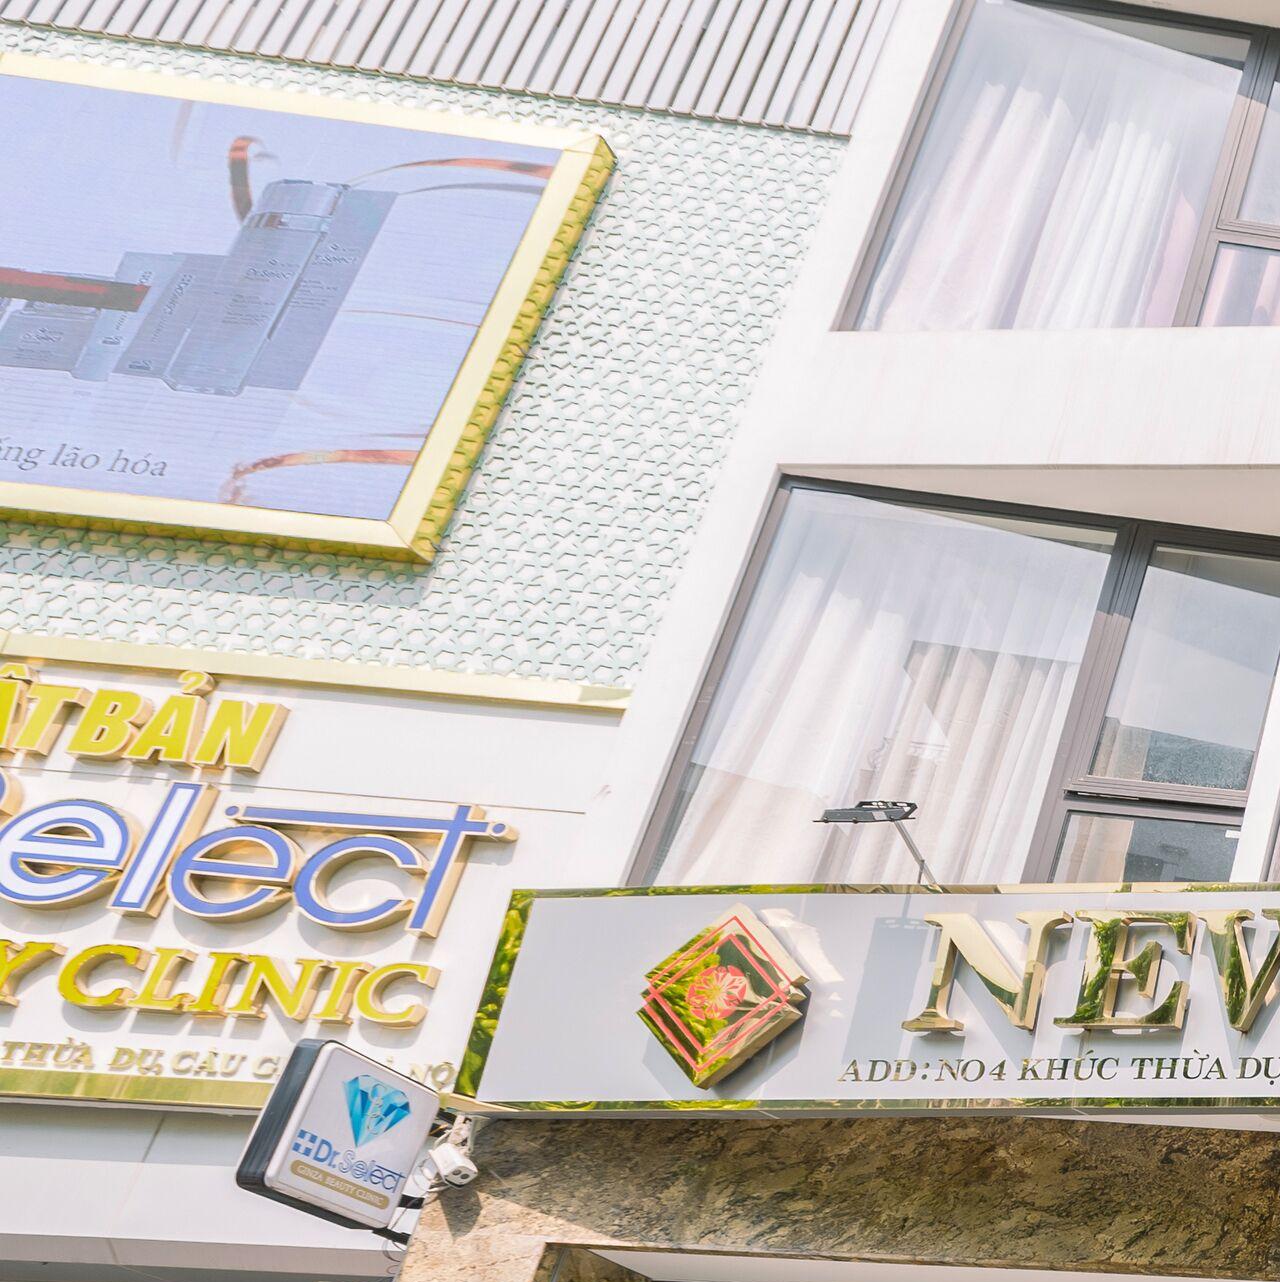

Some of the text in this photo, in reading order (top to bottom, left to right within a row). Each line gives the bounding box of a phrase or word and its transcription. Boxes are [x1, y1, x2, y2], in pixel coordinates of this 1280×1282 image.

[49, 443, 100, 469] lão
[107, 449, 168, 477] hóa
[66, 670, 290, 773] BẢN
[0, 770, 516, 938] elect
[58, 943, 442, 1030] CLINIC
[1017, 1049, 1121, 1081] KHÚC
[1131, 1049, 1228, 1080] THỪA
